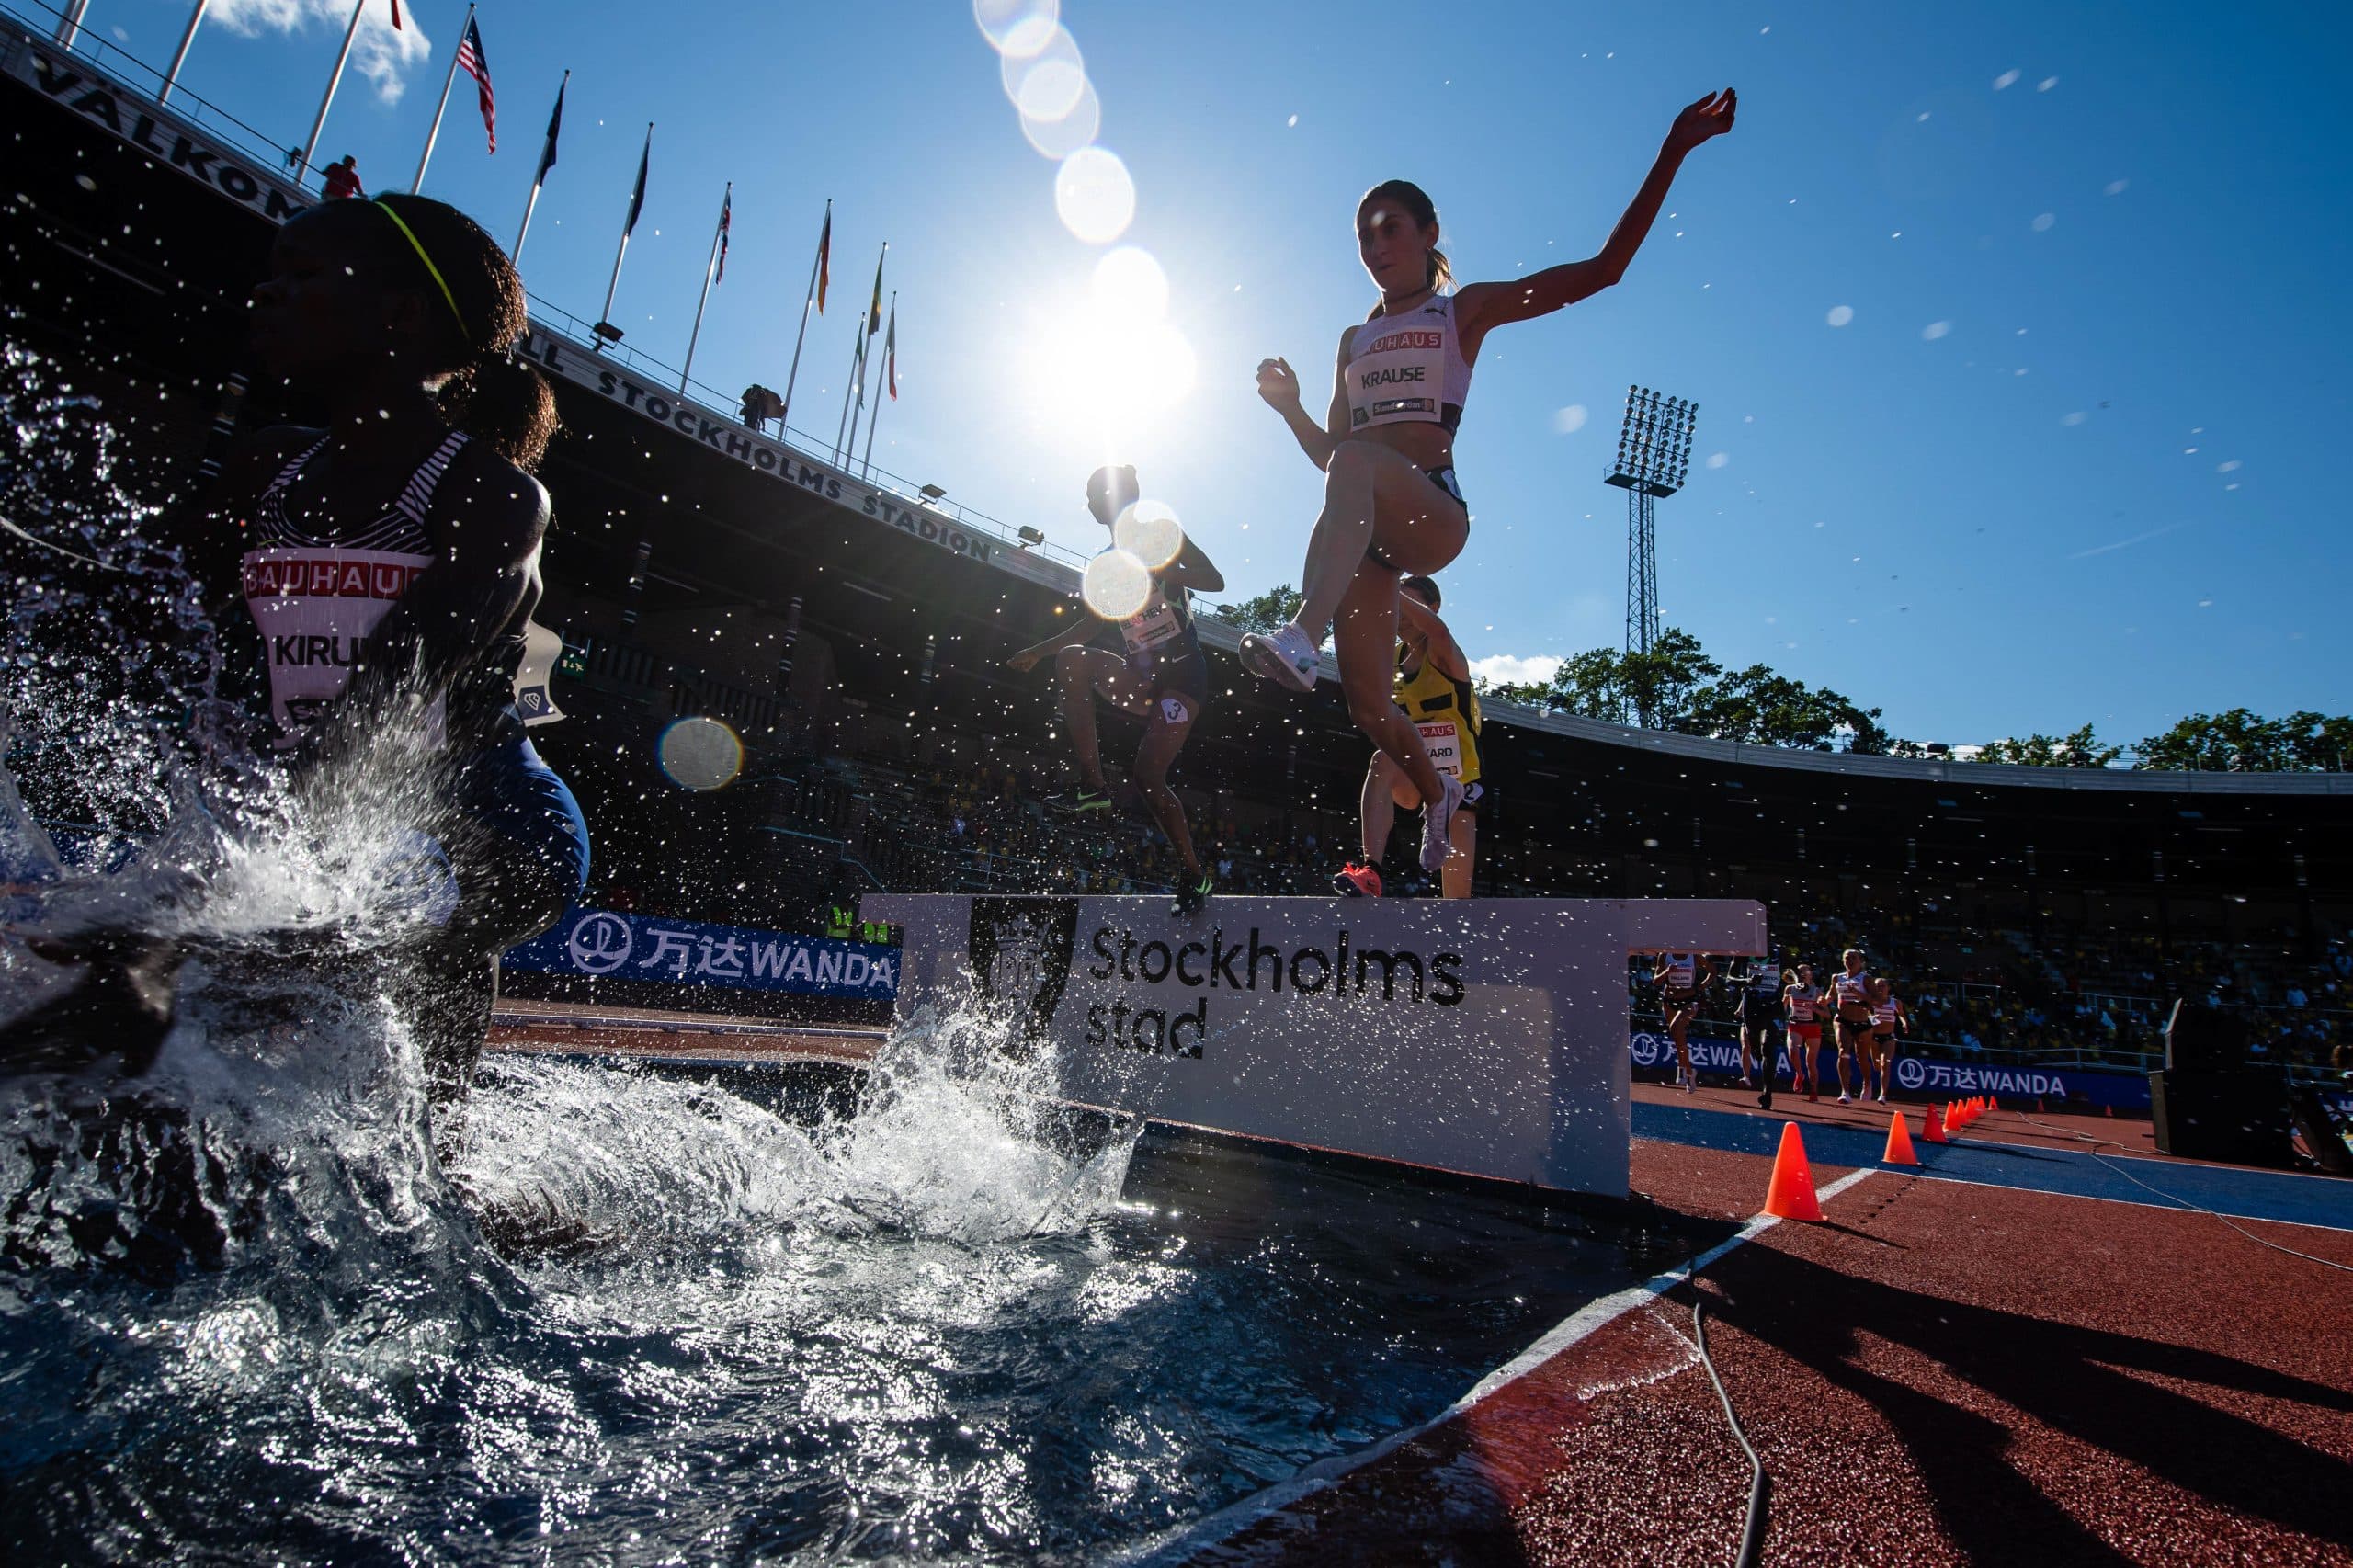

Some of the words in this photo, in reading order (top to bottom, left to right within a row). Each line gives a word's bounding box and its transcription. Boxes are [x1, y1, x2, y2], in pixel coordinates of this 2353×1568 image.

[1370, 333, 1439, 351] UHAUS
[1361, 366, 1426, 390] KRAUSE
[598, 371, 842, 500] STOCKHOLMS
[862, 493, 991, 562] STADION
[1167, 702, 1181, 720] 3
[1421, 726, 1454, 737] HAUS
[1427, 747, 1453, 758] ARD
[751, 940, 895, 990] WANDA
[1091, 926, 1466, 1006] Stockholms
[1085, 996, 1207, 1060] stad
[1978, 1070, 2067, 1096] WANDA
